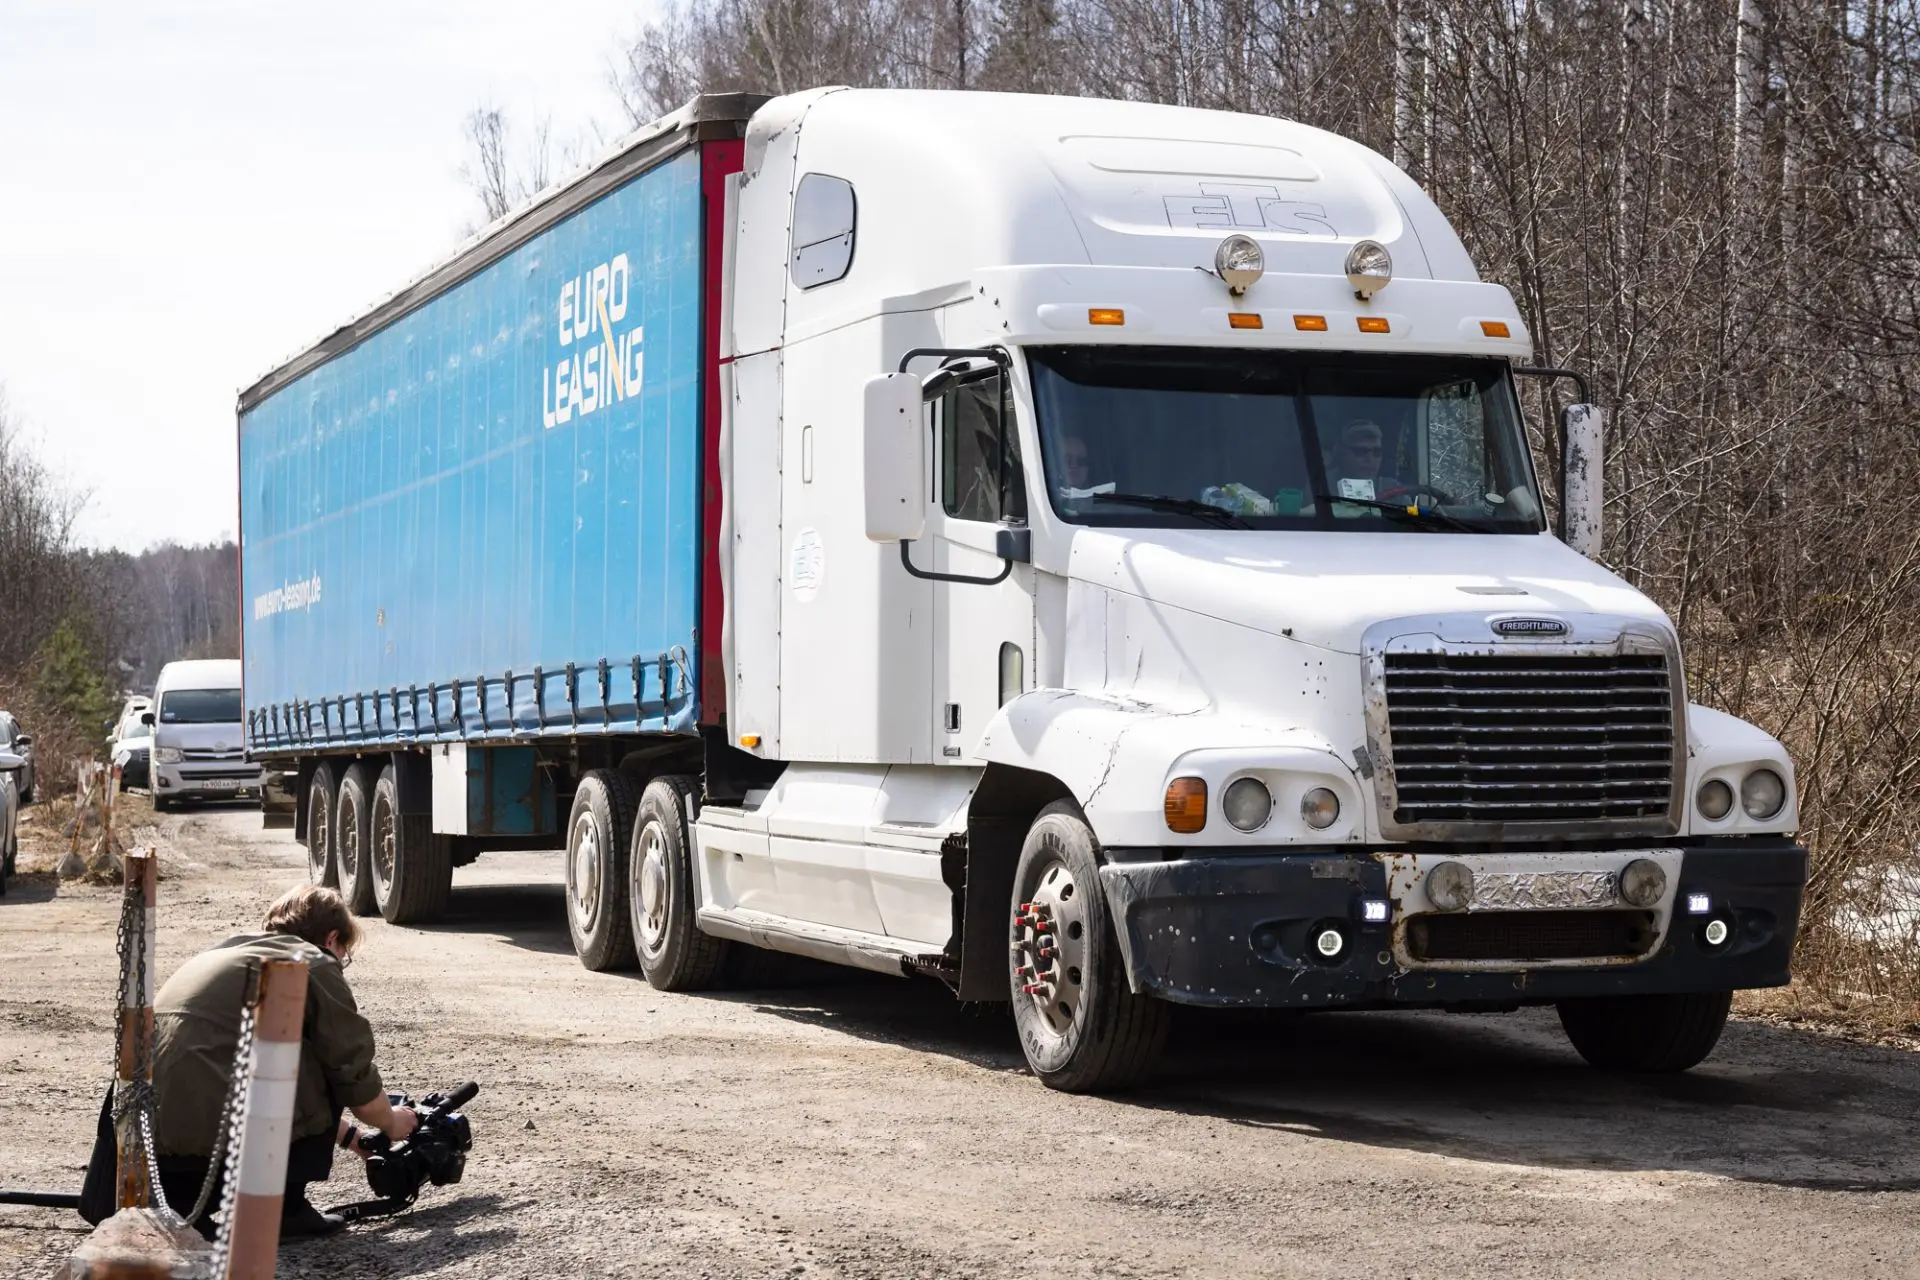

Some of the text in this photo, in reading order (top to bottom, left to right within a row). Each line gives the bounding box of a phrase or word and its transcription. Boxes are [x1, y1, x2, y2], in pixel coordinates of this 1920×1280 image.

[559, 253, 629, 347] EURO
[543, 326, 644, 429] LEASING
[1502, 620, 1560, 631] FREIGHTLINER
